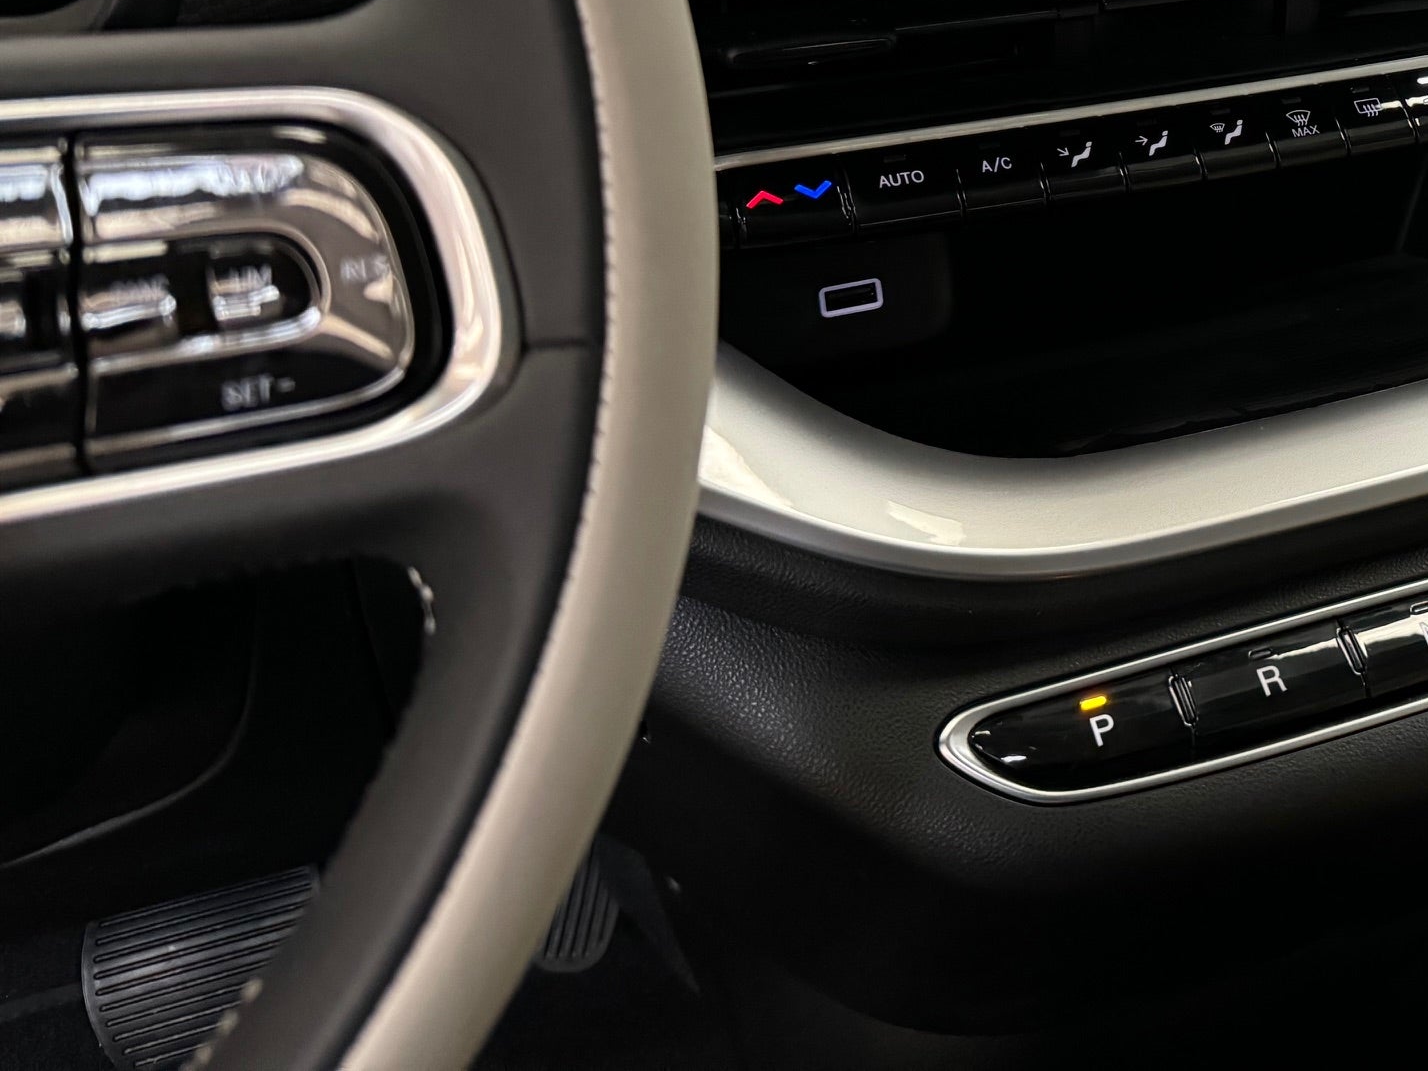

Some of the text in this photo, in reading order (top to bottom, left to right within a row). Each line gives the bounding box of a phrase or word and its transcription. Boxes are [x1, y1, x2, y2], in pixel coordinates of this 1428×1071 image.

[1291, 121, 1320, 138] MAX
[982, 157, 1012, 173] A/C
[879, 170, 925, 188] AUTO
[1256, 665, 1288, 697] R
[1089, 713, 1115, 747] P
